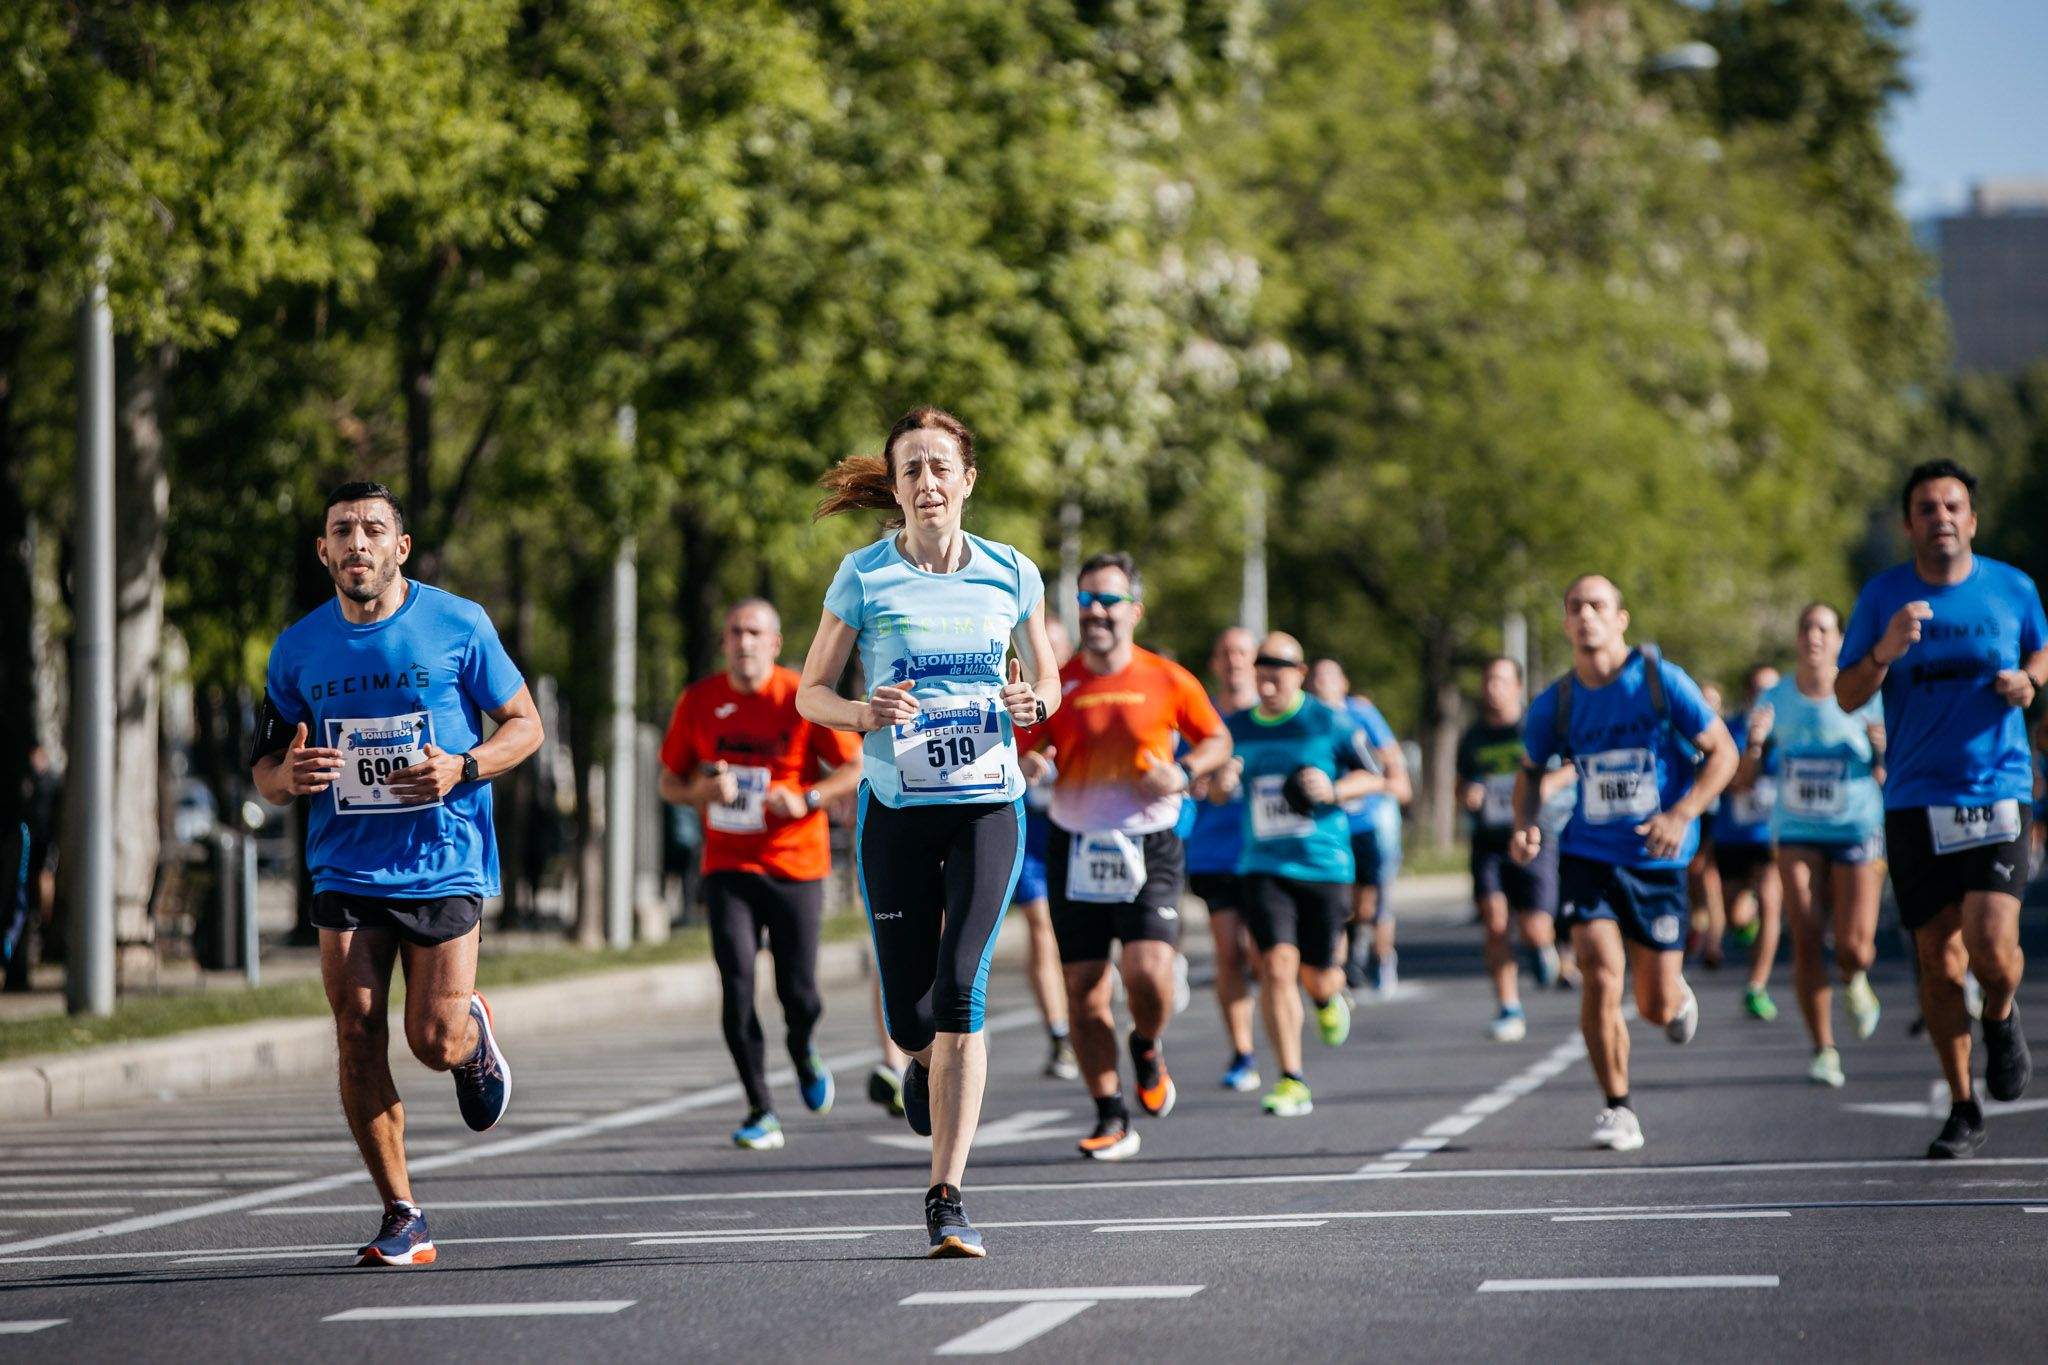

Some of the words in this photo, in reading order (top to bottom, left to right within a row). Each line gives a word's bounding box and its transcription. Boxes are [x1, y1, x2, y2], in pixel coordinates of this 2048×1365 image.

[917, 653, 1000, 667] BOMBEROS
[950, 665, 962, 675] de
[311, 671, 430, 701] DECIMAS
[928, 710, 979, 720] BOMBEROS
[361, 729, 412, 740] BOMBEROS
[926, 726, 980, 737] DECIMAS
[358, 744, 412, 756] DECIMAS
[927, 737, 976, 767] 519
